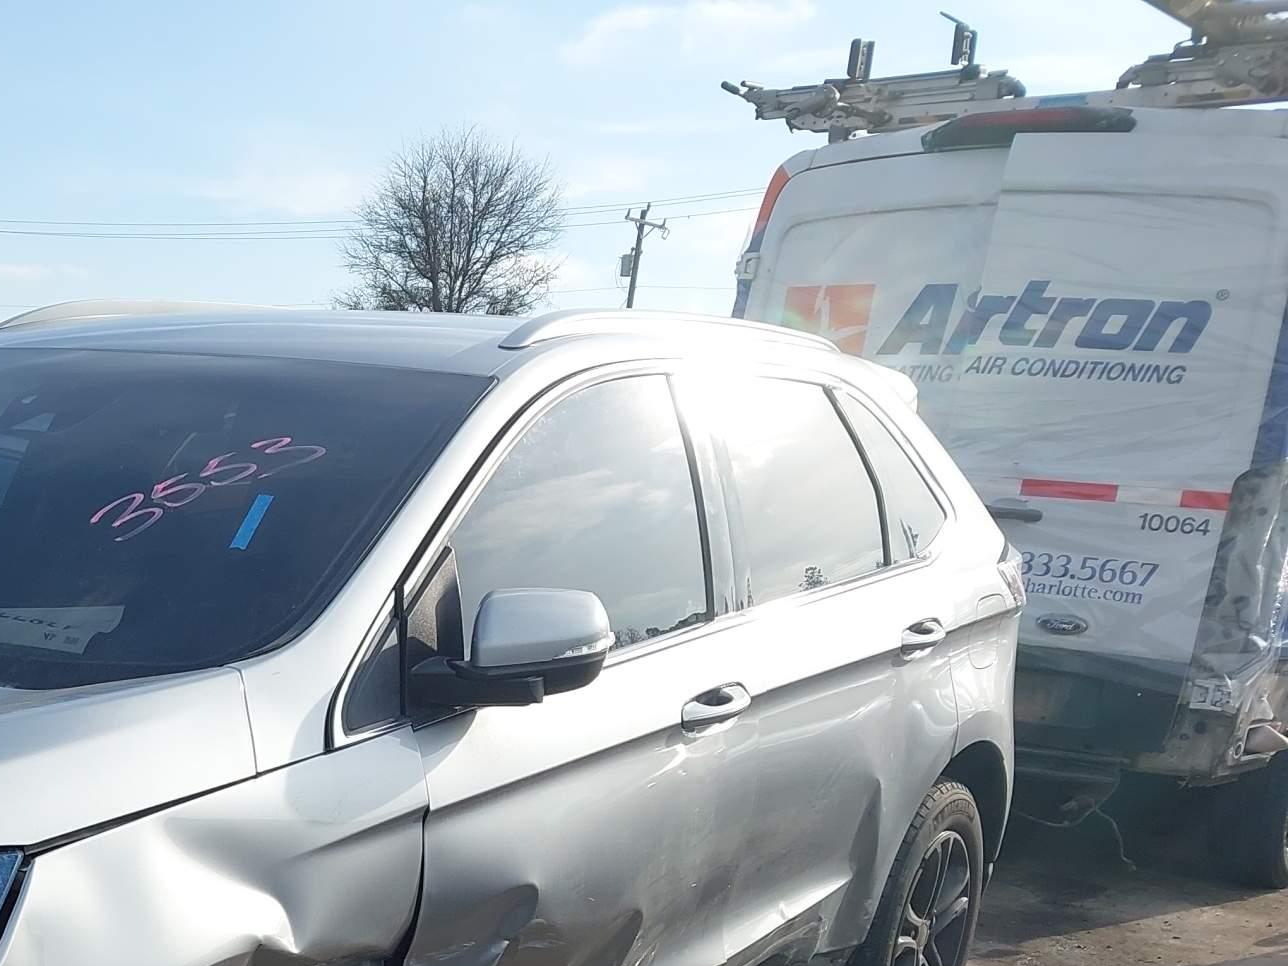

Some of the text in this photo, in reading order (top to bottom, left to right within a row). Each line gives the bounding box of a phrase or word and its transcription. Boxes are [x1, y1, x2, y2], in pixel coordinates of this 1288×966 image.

[965, 355, 1007, 375] AIR
[1011, 357, 1187, 385] CONDITIONING
[90, 437, 327, 542] 3553
[1138, 512, 1211, 536] 10064
[1022, 577, 1143, 605] harlotte.com
